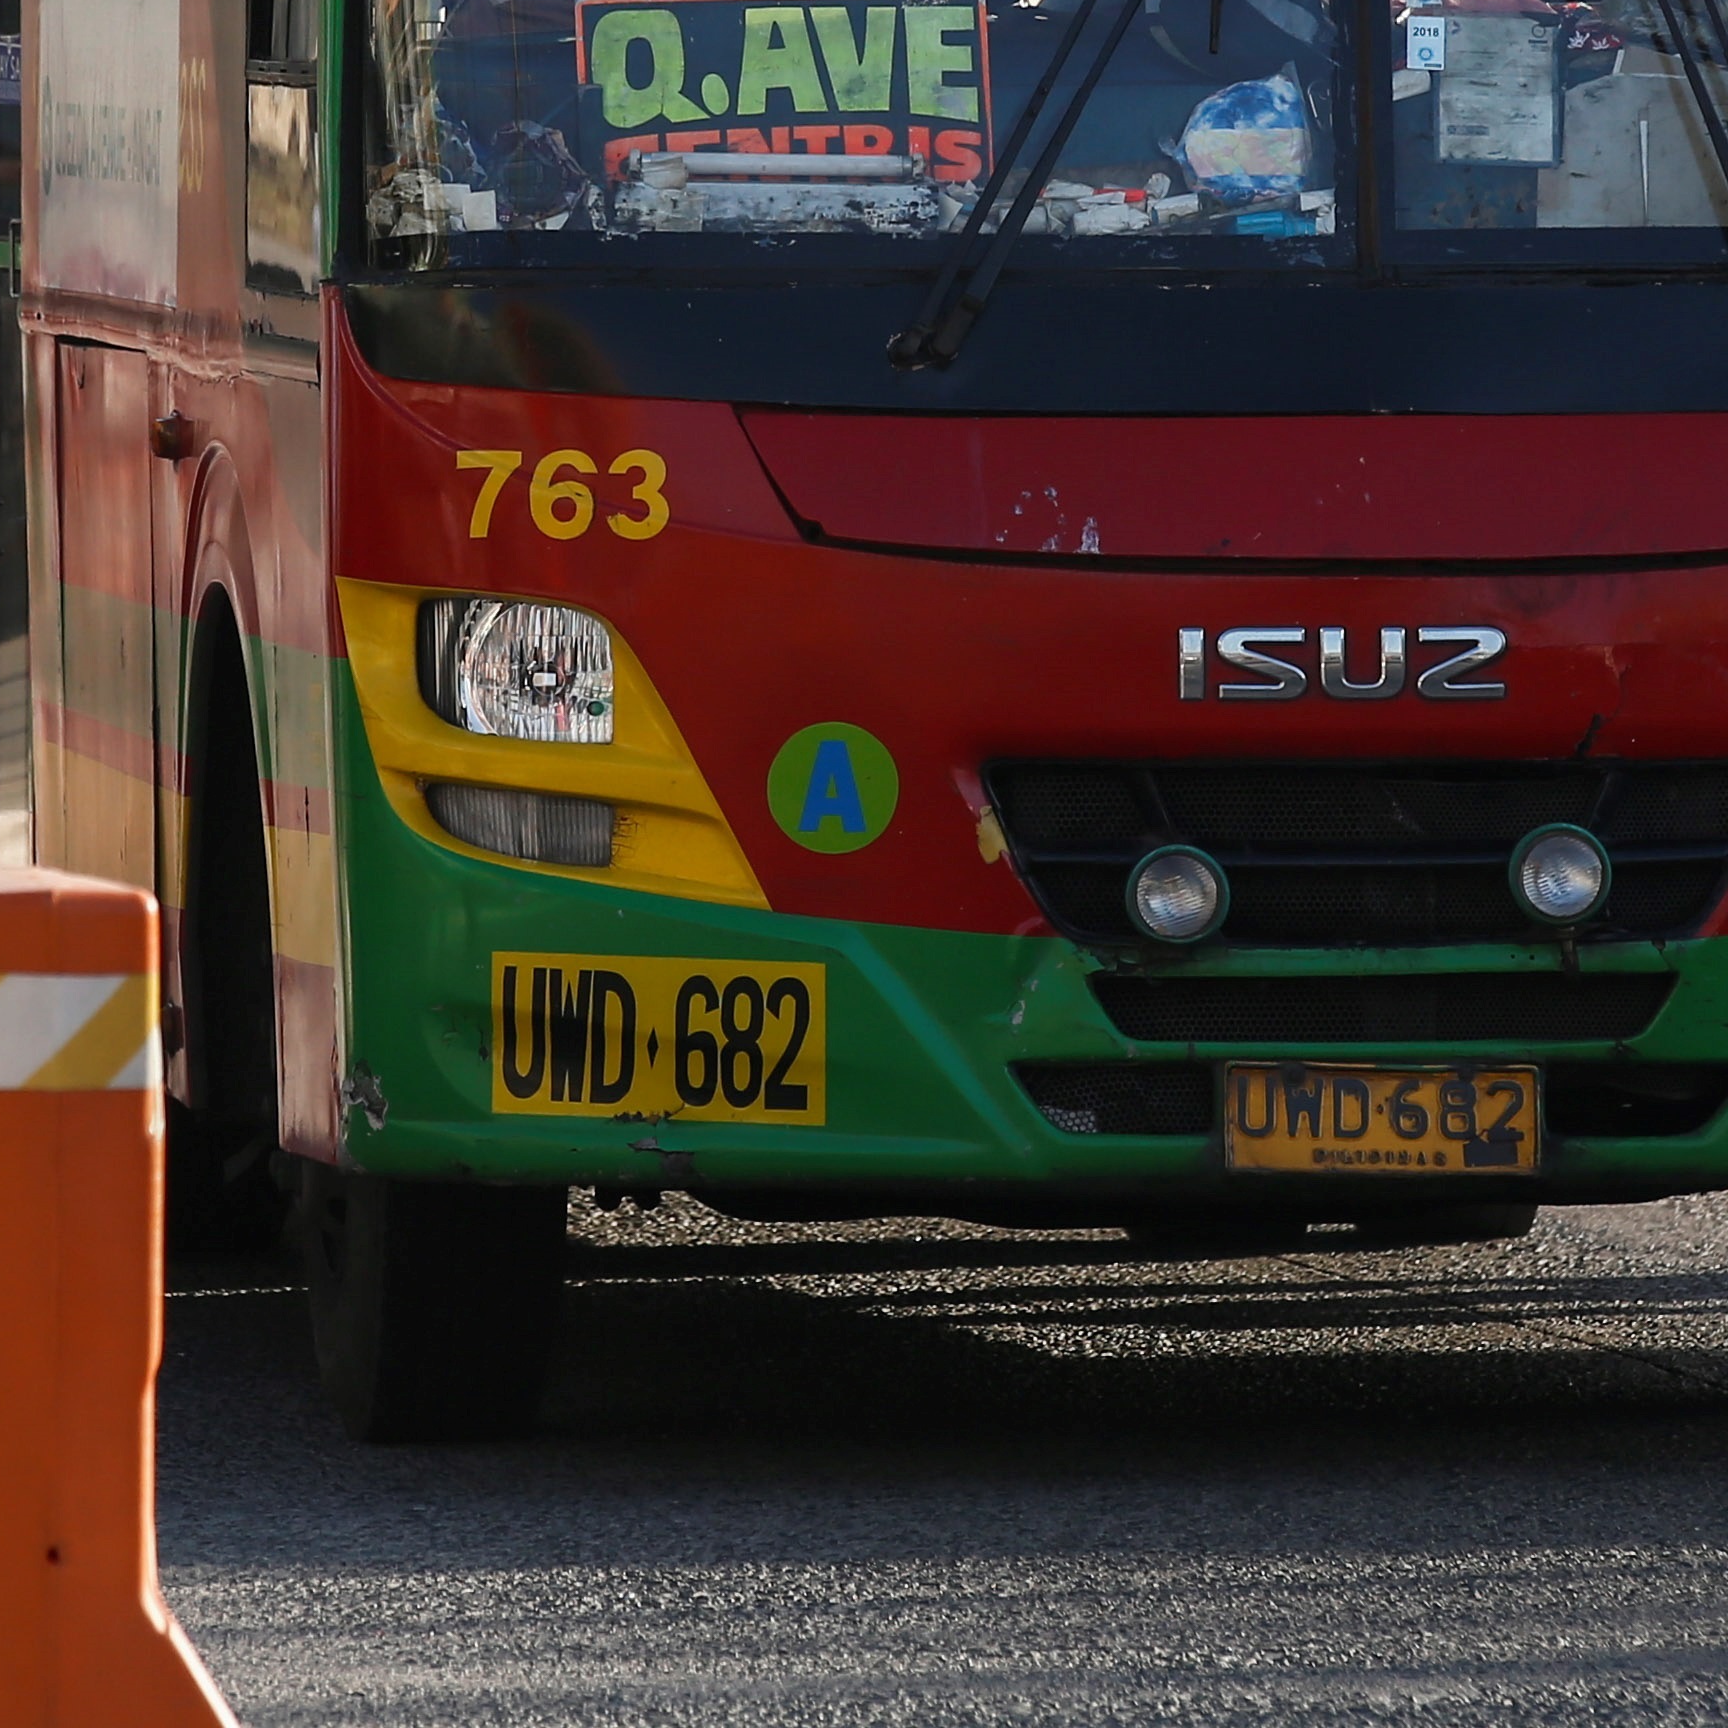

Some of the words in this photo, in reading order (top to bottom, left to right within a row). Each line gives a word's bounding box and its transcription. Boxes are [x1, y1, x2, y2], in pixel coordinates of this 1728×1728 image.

[591, 6, 980, 128] Q.AVE
[1412, 27, 1440, 38] 2018
[454, 448, 671, 541] 763
[1177, 624, 1508, 701] ISUZ
[796, 739, 867, 835] A
